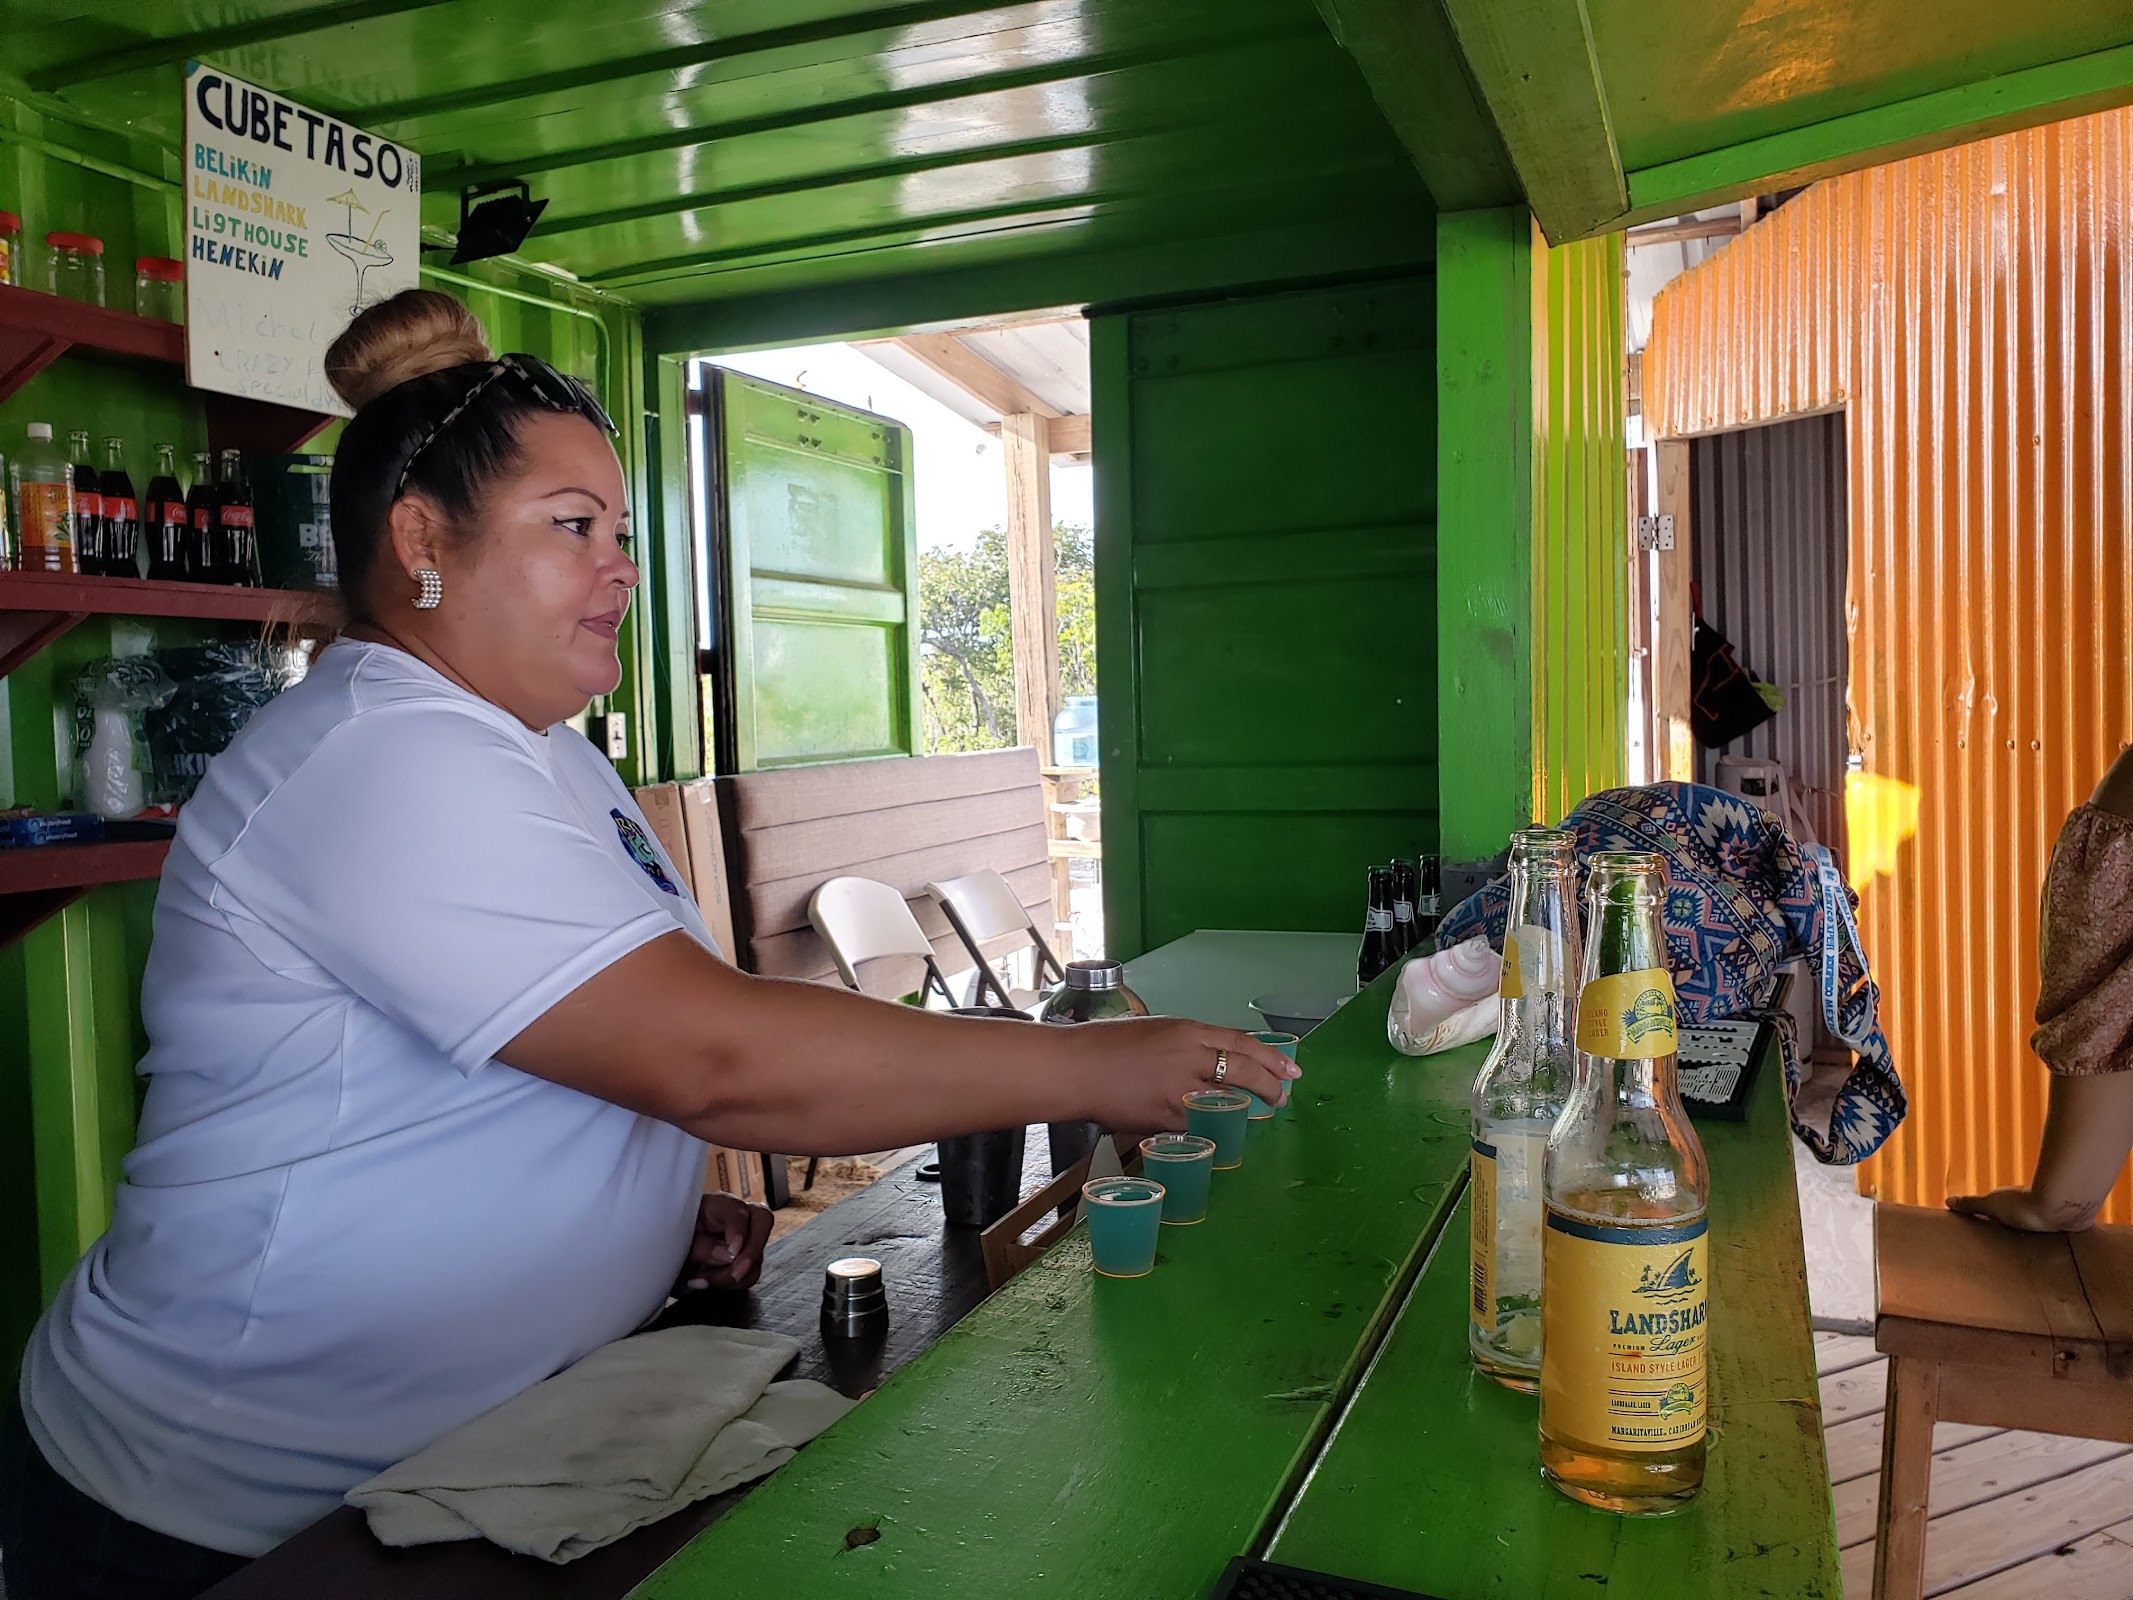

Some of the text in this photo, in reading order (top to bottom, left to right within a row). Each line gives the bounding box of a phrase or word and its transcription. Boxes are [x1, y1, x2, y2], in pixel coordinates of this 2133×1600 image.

[197, 75, 402, 188] CUBETASO
[193, 175, 308, 230] LANDSHARK
[1649, 1334, 1697, 1356] Lager
[1611, 1355, 1697, 1374] ISLAND STYLE LAGER
